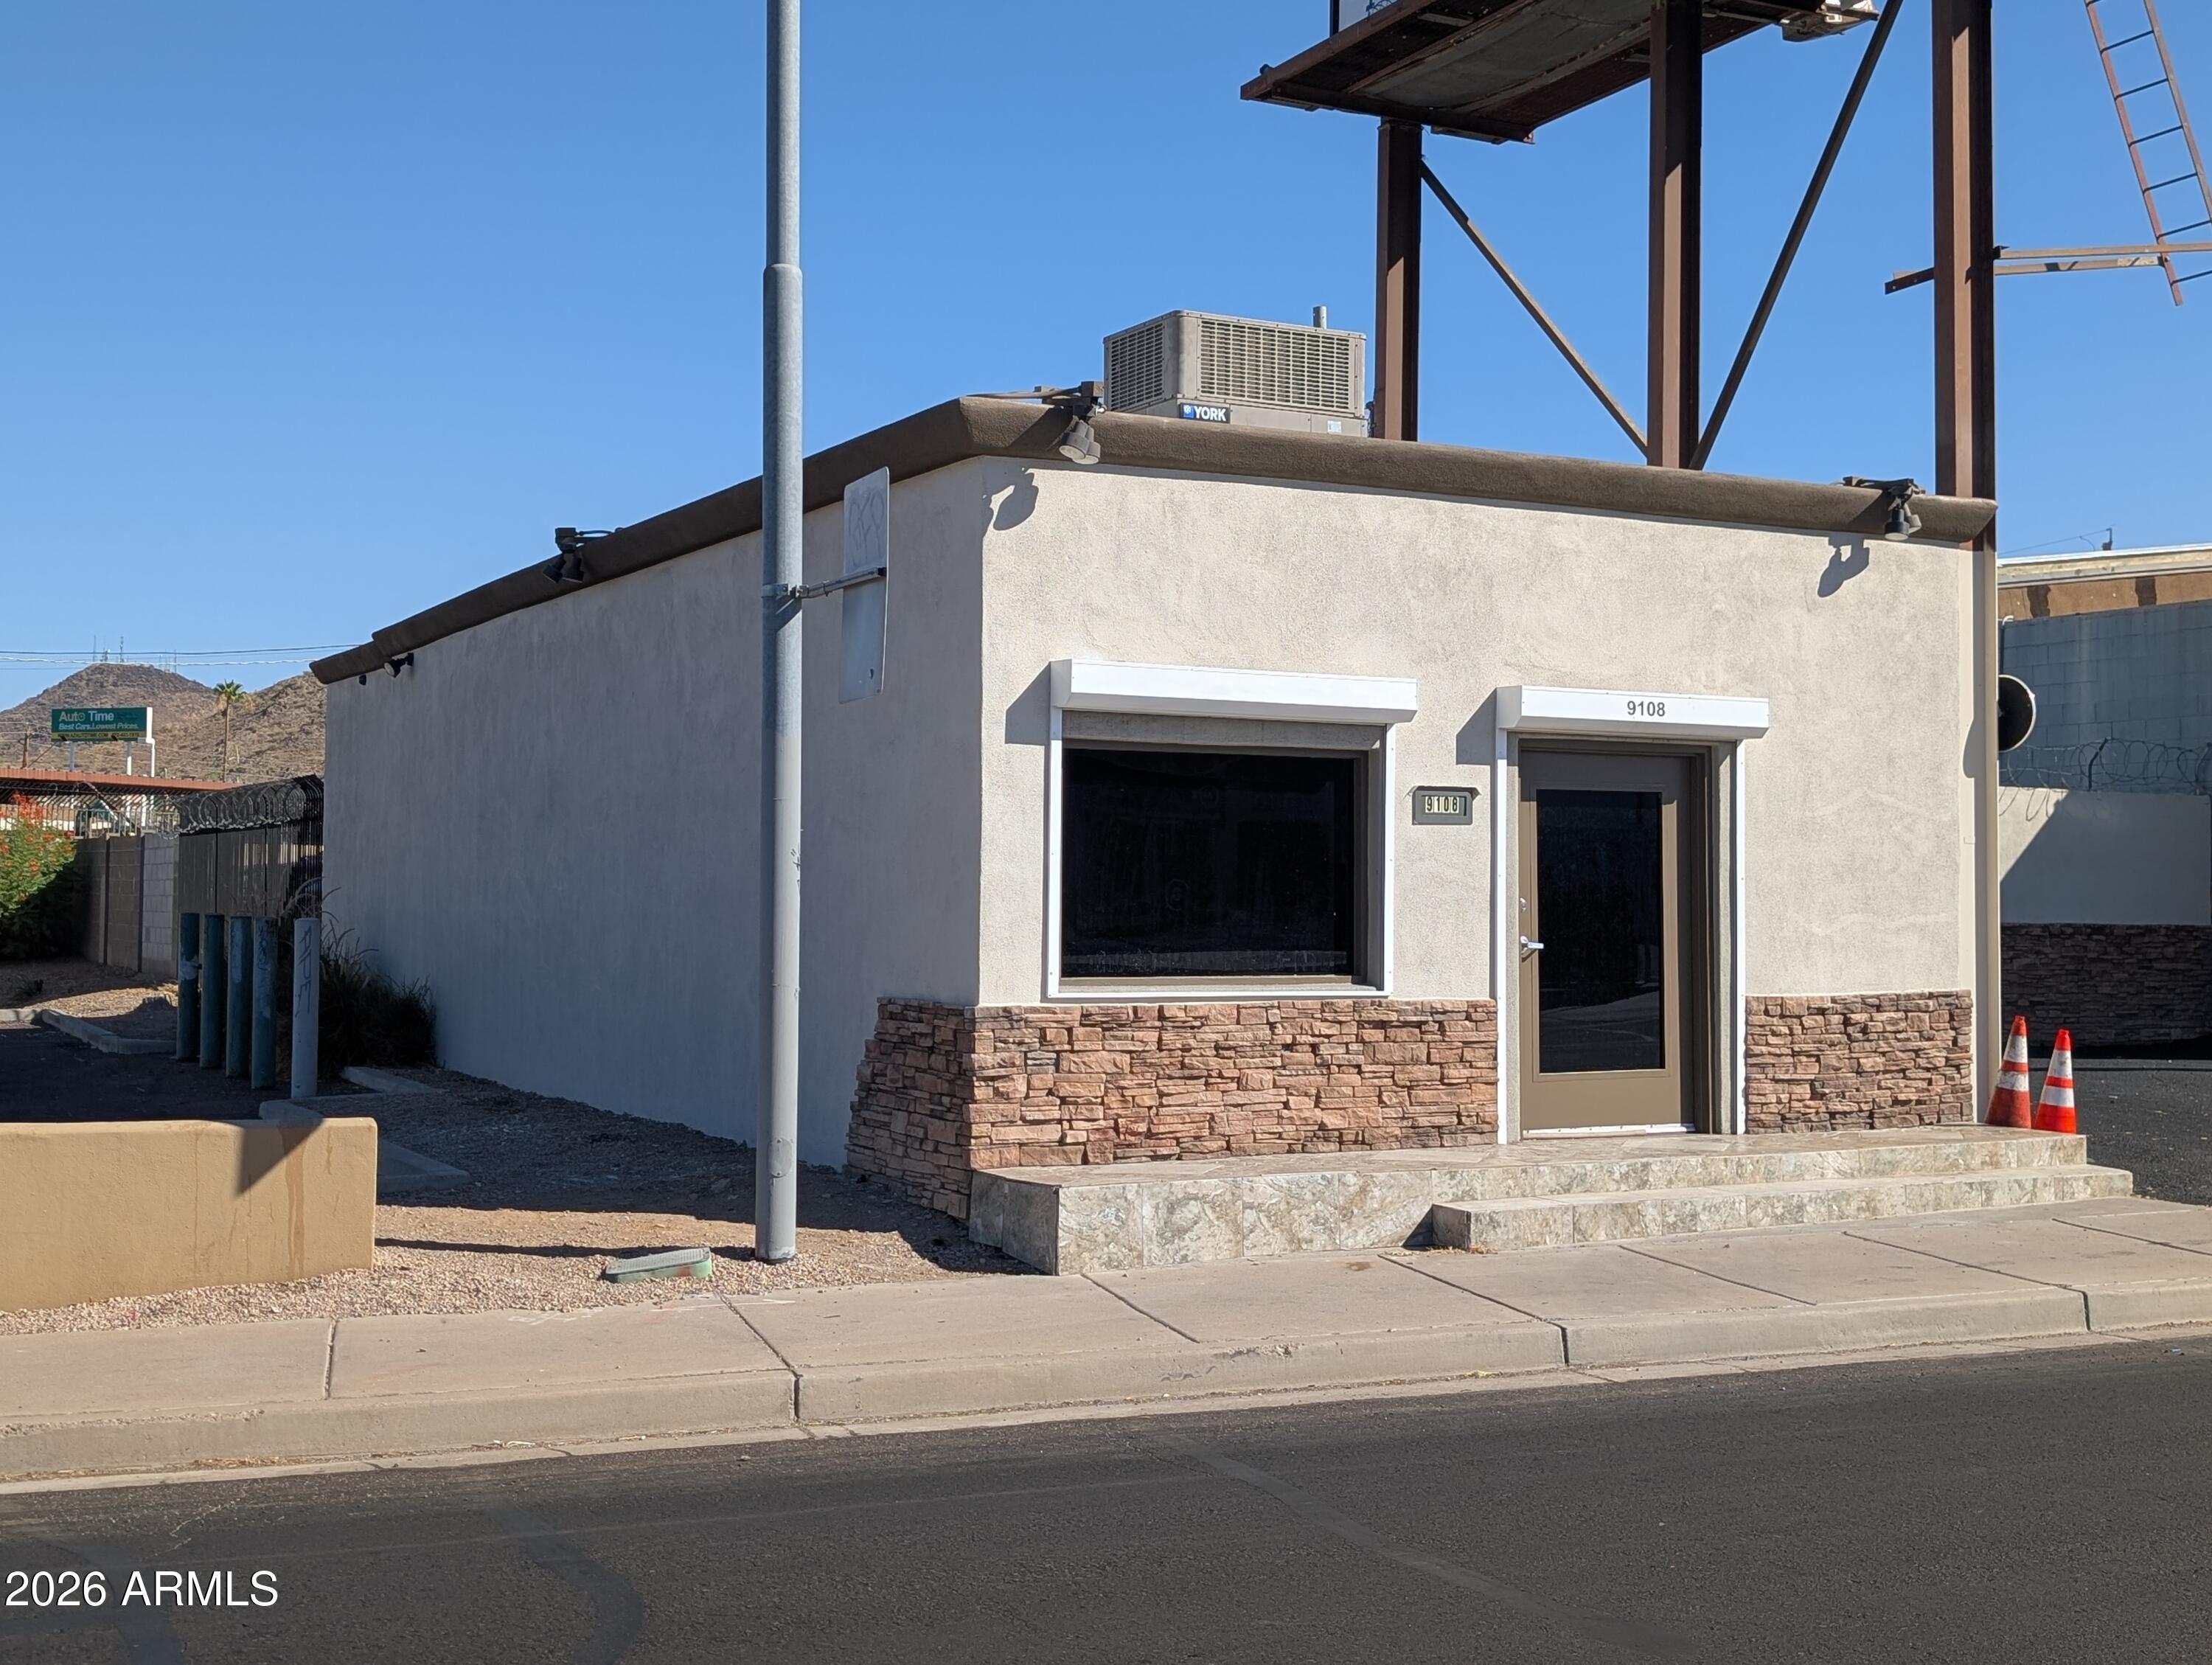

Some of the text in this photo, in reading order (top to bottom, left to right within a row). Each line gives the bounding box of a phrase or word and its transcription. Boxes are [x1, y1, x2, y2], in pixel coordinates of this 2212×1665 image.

[1194, 406, 1226, 421] YORK
[59, 711, 114, 721] Auto Time
[1627, 701, 1666, 717] 9108
[1427, 796, 1458, 812] 9108
